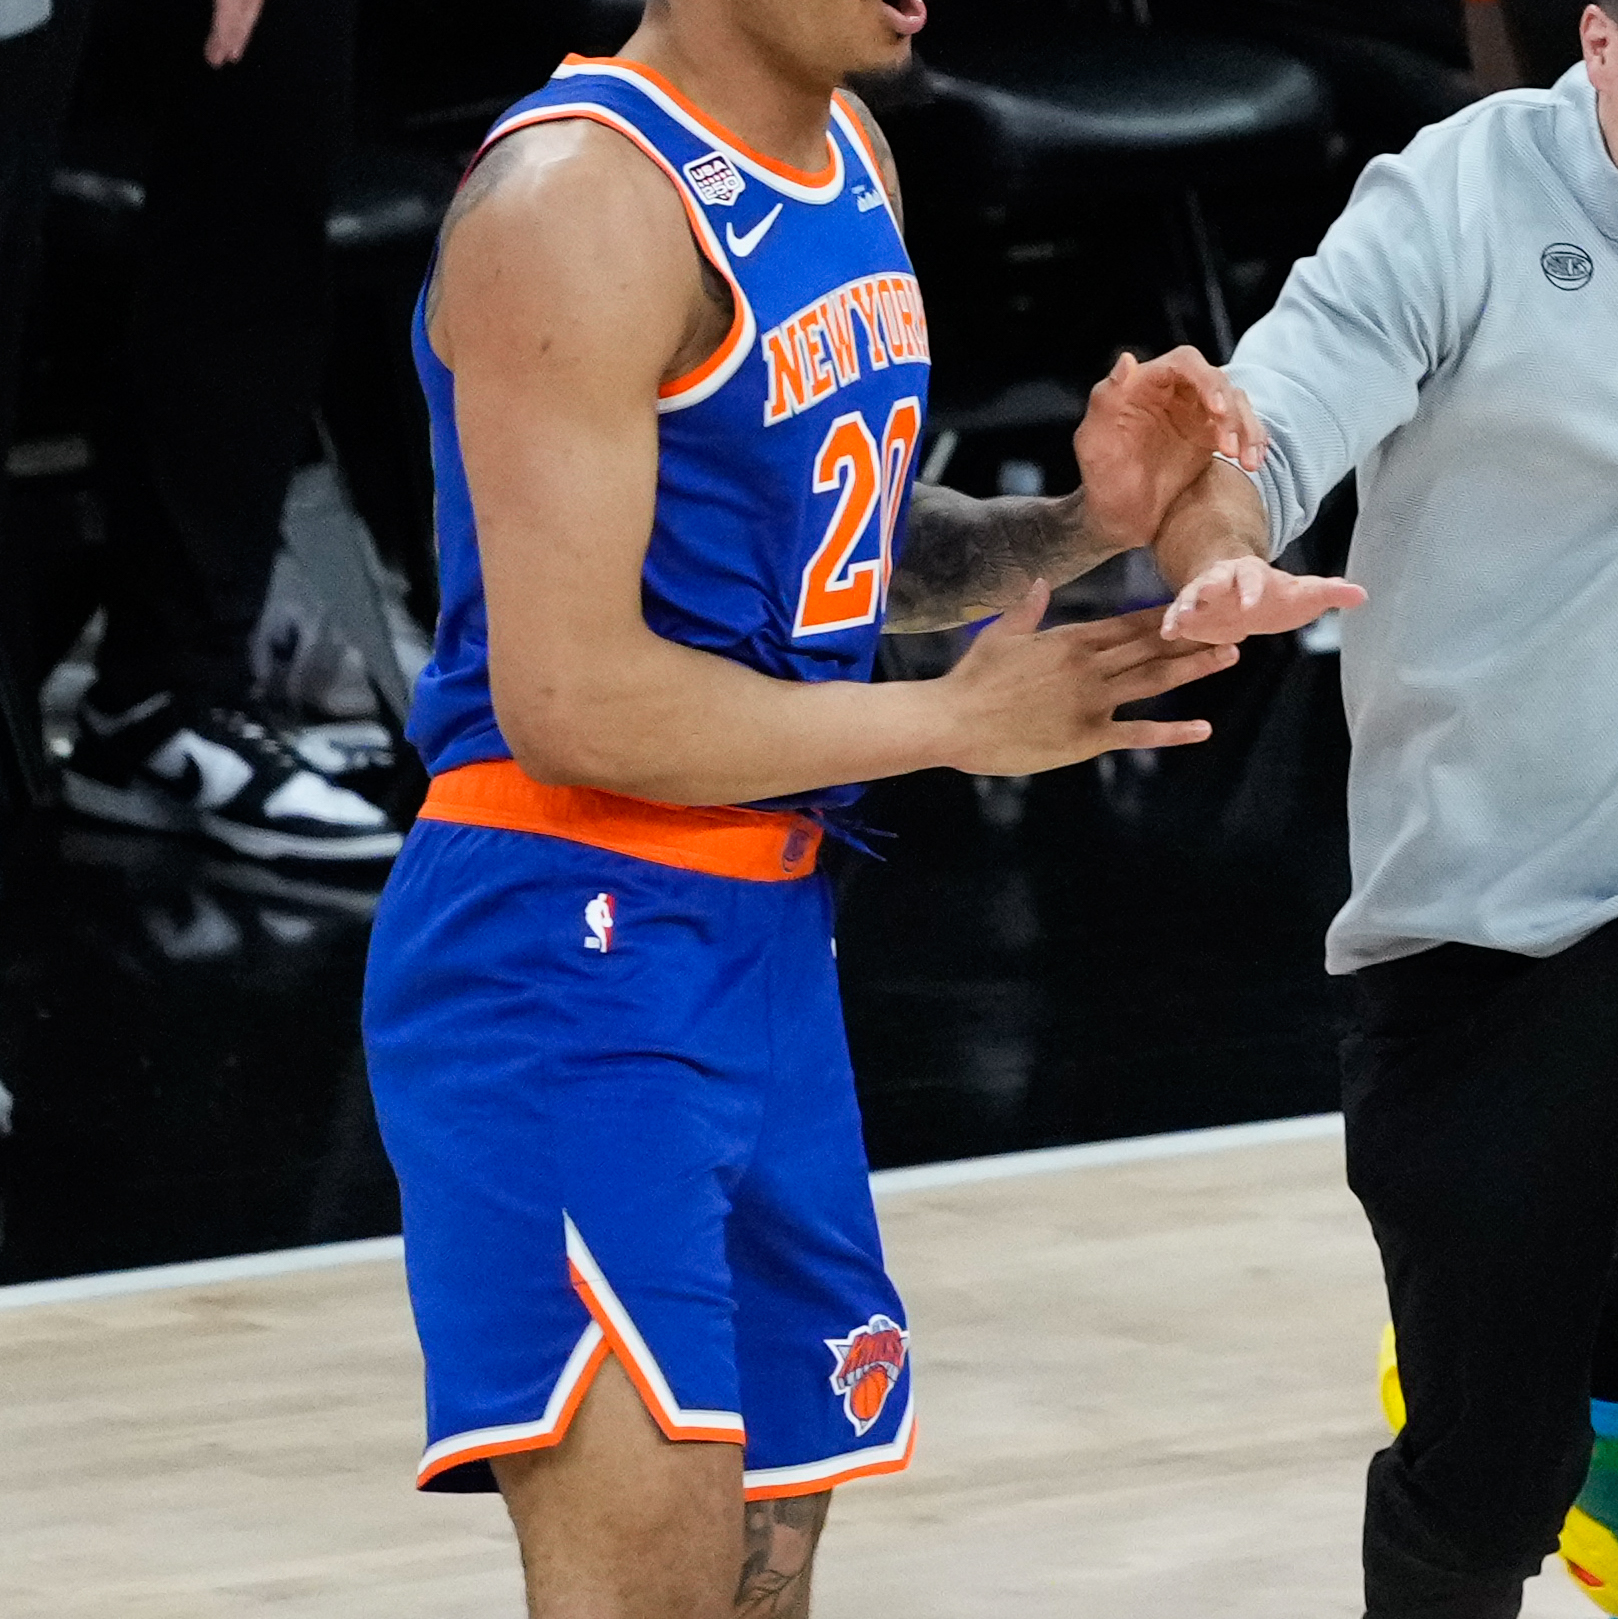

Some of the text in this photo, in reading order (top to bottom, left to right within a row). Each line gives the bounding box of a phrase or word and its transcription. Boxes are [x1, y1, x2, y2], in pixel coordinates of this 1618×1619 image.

[691, 157, 728, 181] USA
[702, 177, 738, 200] 250
[762, 290, 862, 428] NEW
[790, 394, 922, 639] 20
